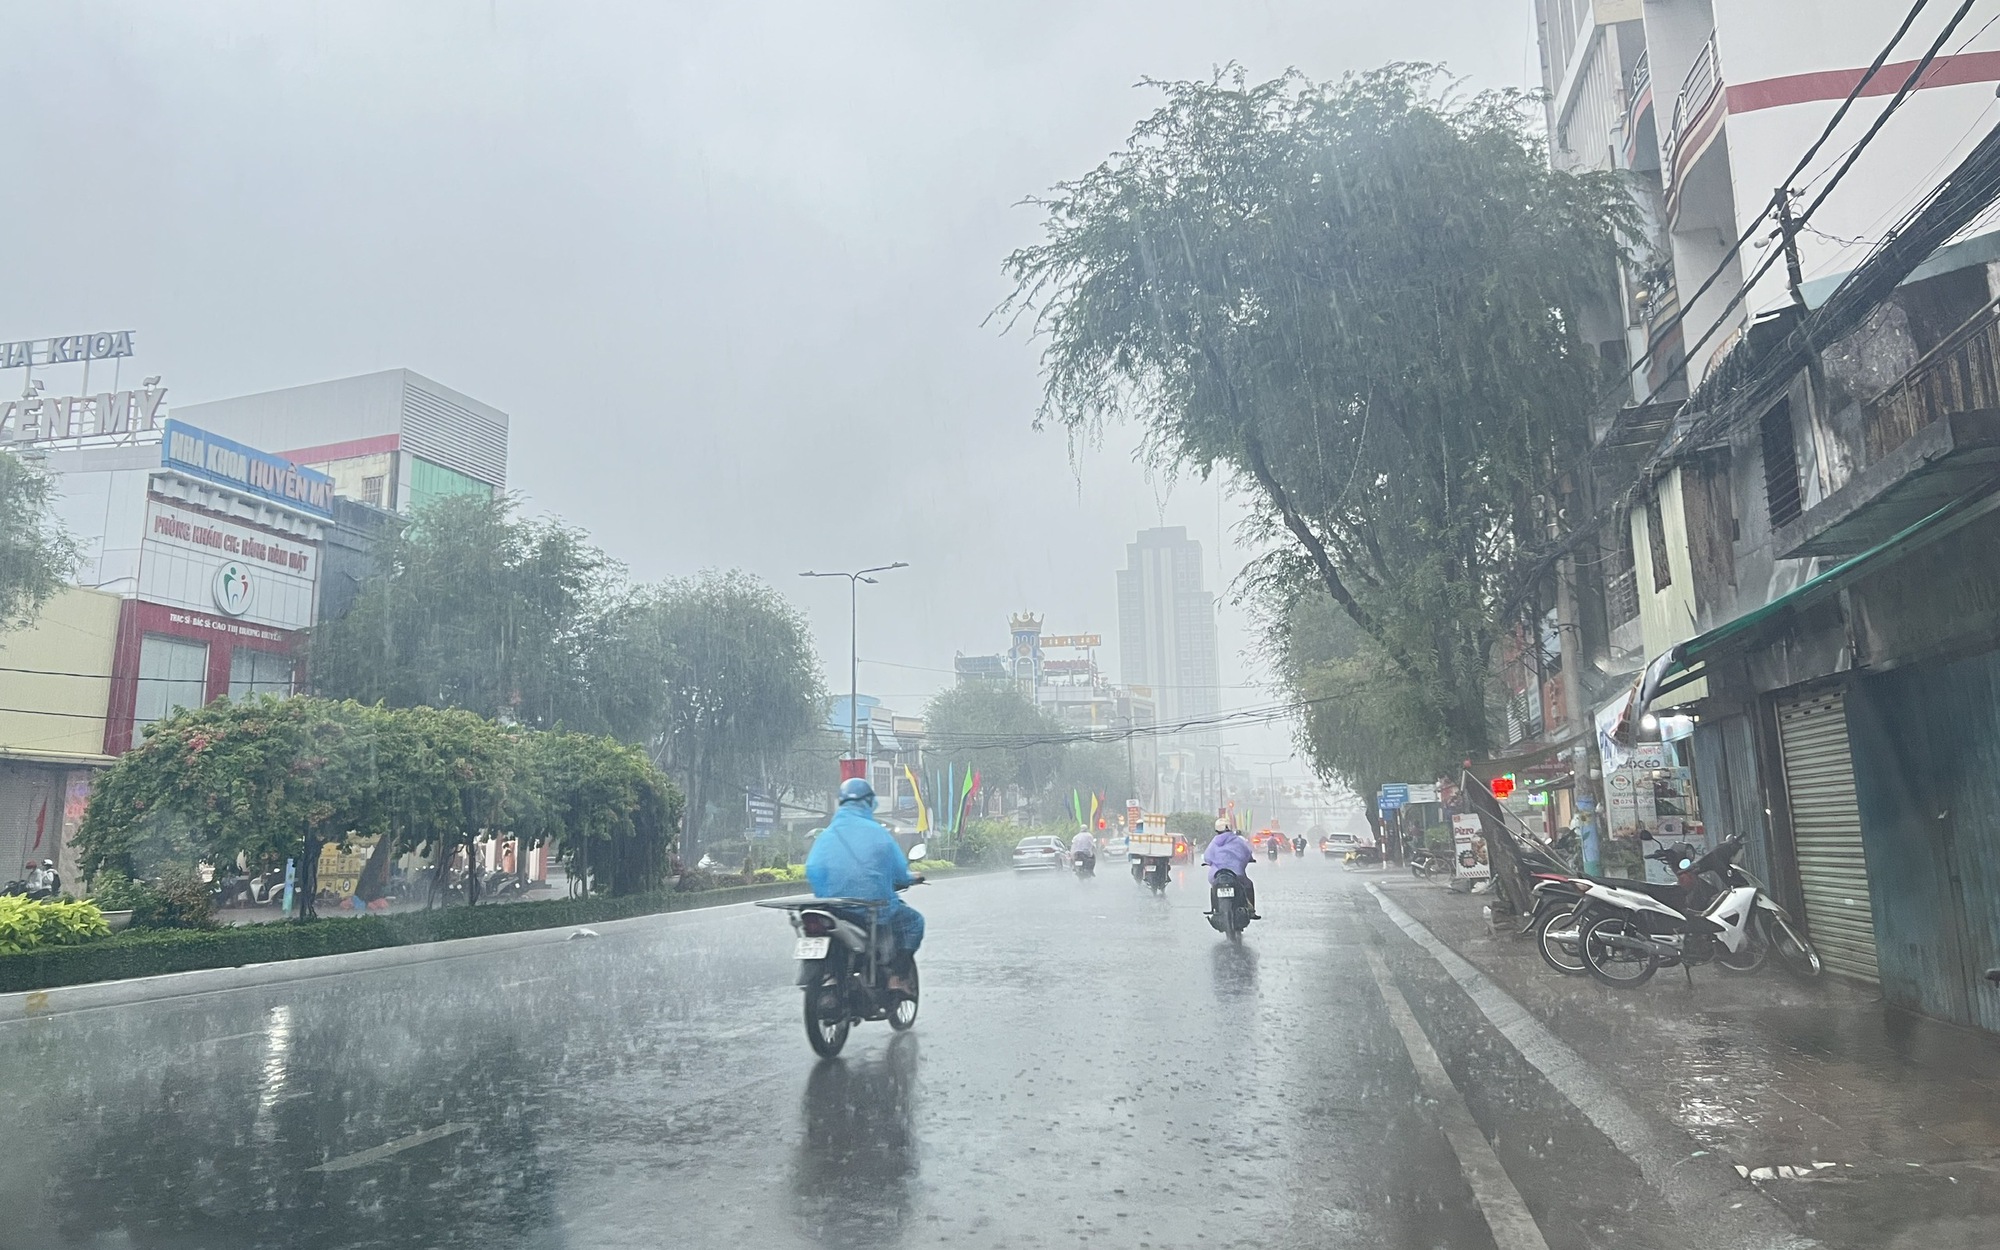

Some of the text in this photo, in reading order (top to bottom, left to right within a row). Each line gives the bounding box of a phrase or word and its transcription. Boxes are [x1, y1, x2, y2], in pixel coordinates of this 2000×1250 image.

[47, 331, 133, 363] KHOA
[93, 376, 168, 434] MỸ
[170, 431, 206, 468] NHA
[206, 444, 248, 483] KHOA
[250, 462, 308, 502] HUYỀN
[154, 514, 191, 541] PHÒNG
[212, 621, 226, 631] CAO
